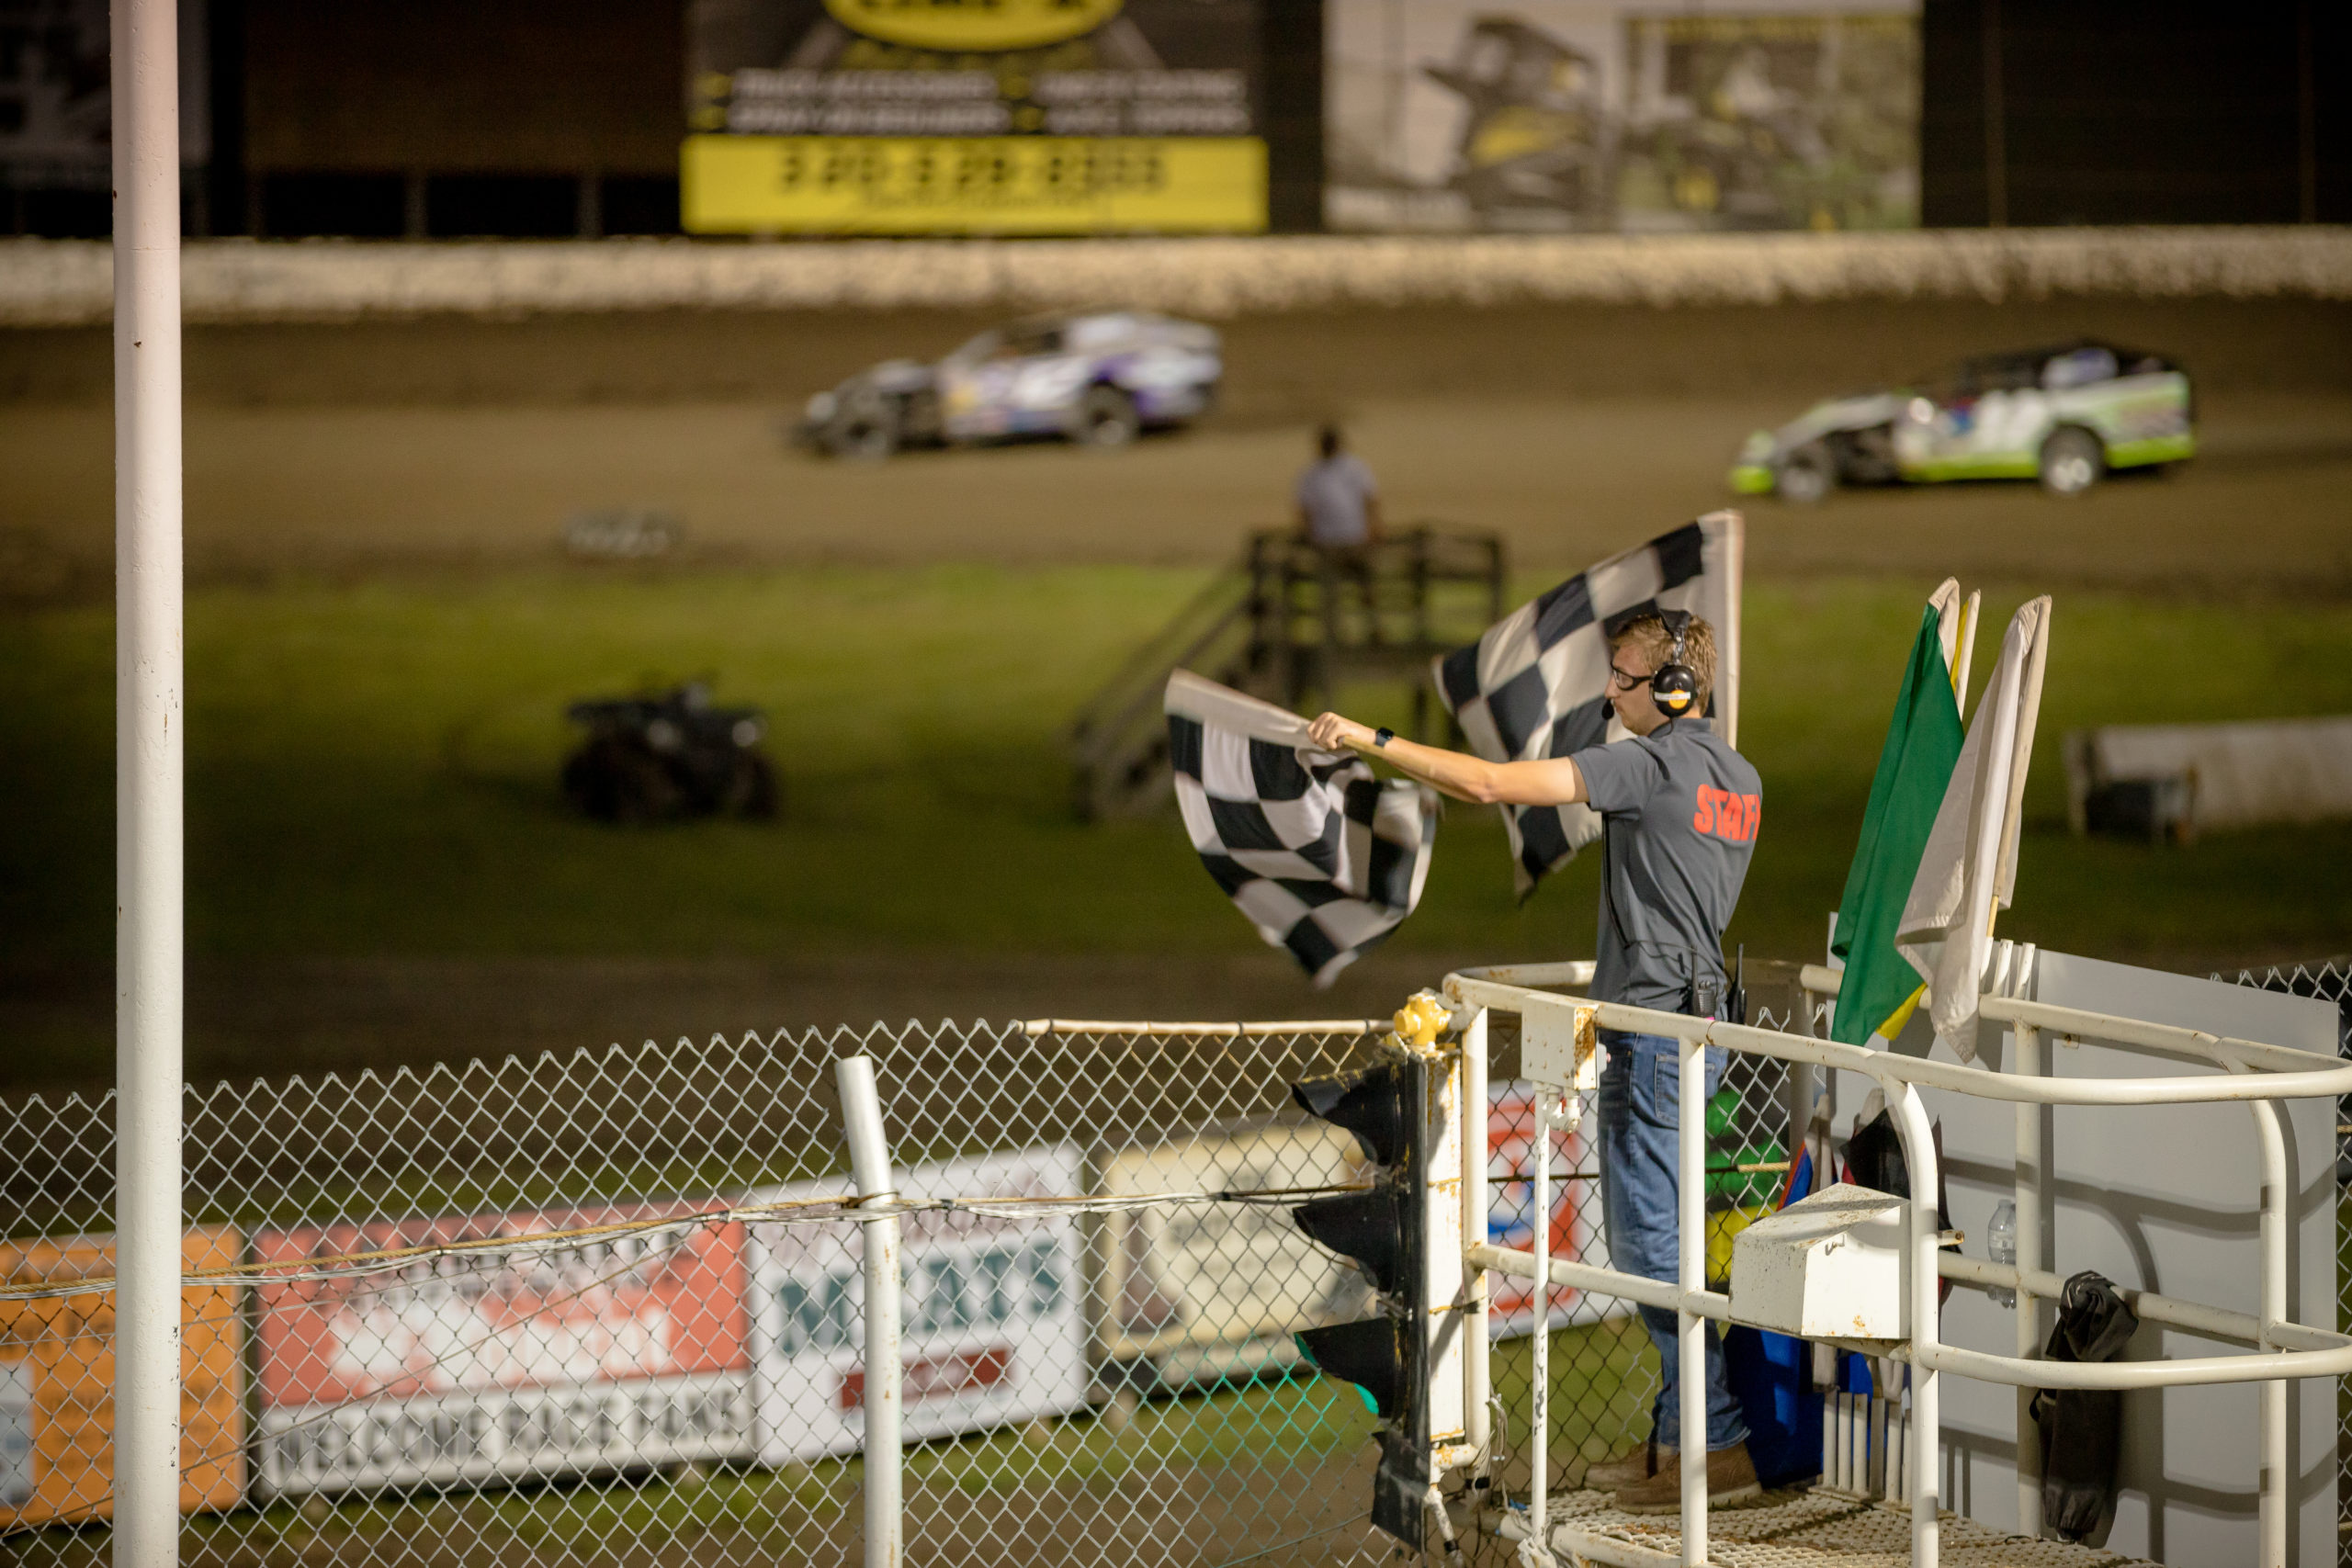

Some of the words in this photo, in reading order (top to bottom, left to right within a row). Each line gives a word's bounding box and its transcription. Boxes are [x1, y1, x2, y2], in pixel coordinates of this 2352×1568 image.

[778, 1242, 1062, 1358] MATS
[273, 1409, 484, 1472] WELCOME
[504, 1397, 616, 1450] RACE
[636, 1387, 739, 1443] FANS
